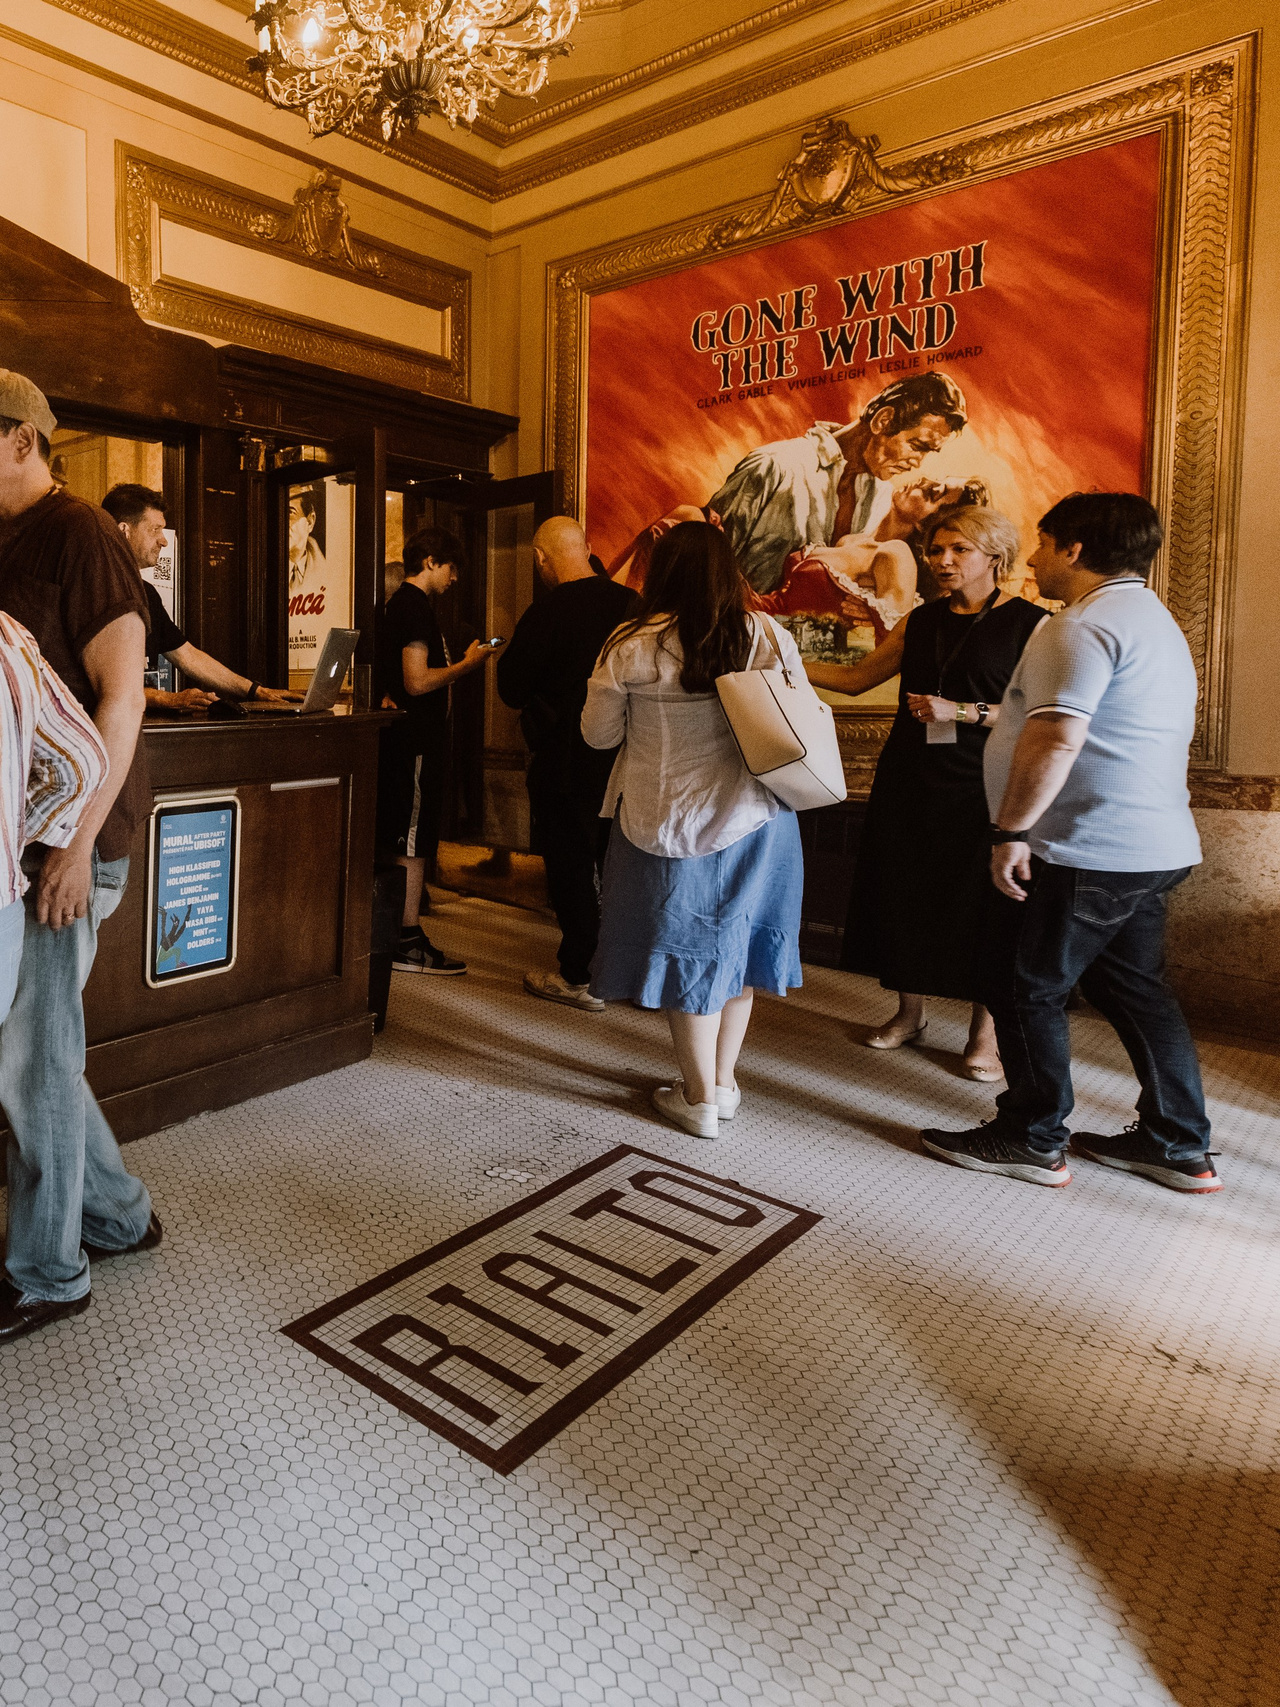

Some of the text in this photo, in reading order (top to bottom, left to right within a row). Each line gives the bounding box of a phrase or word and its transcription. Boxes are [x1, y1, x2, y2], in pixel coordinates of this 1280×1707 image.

[690, 239, 989, 352] GONE WITH
[712, 301, 958, 392] THE WIND
[696, 345, 983, 409] CLARK GABLE VIVIEN LEIGH LESLIE HOWARD
[163, 834, 193, 848] MURAL
[194, 837, 226, 850] UBISOFT
[169, 860, 221, 875] HIGH KLASSIFIED
[166, 872, 211, 887] HOLOGRAMME
[180, 885, 203, 895] LUNICE
[164, 893, 219, 910] JAMES BENJAMIN
[197, 905, 214, 915] YAYA
[185, 917, 203, 928] WASA
[187, 937, 214, 949] DOLDERS
[349, 1170, 767, 1427] RIALTO
